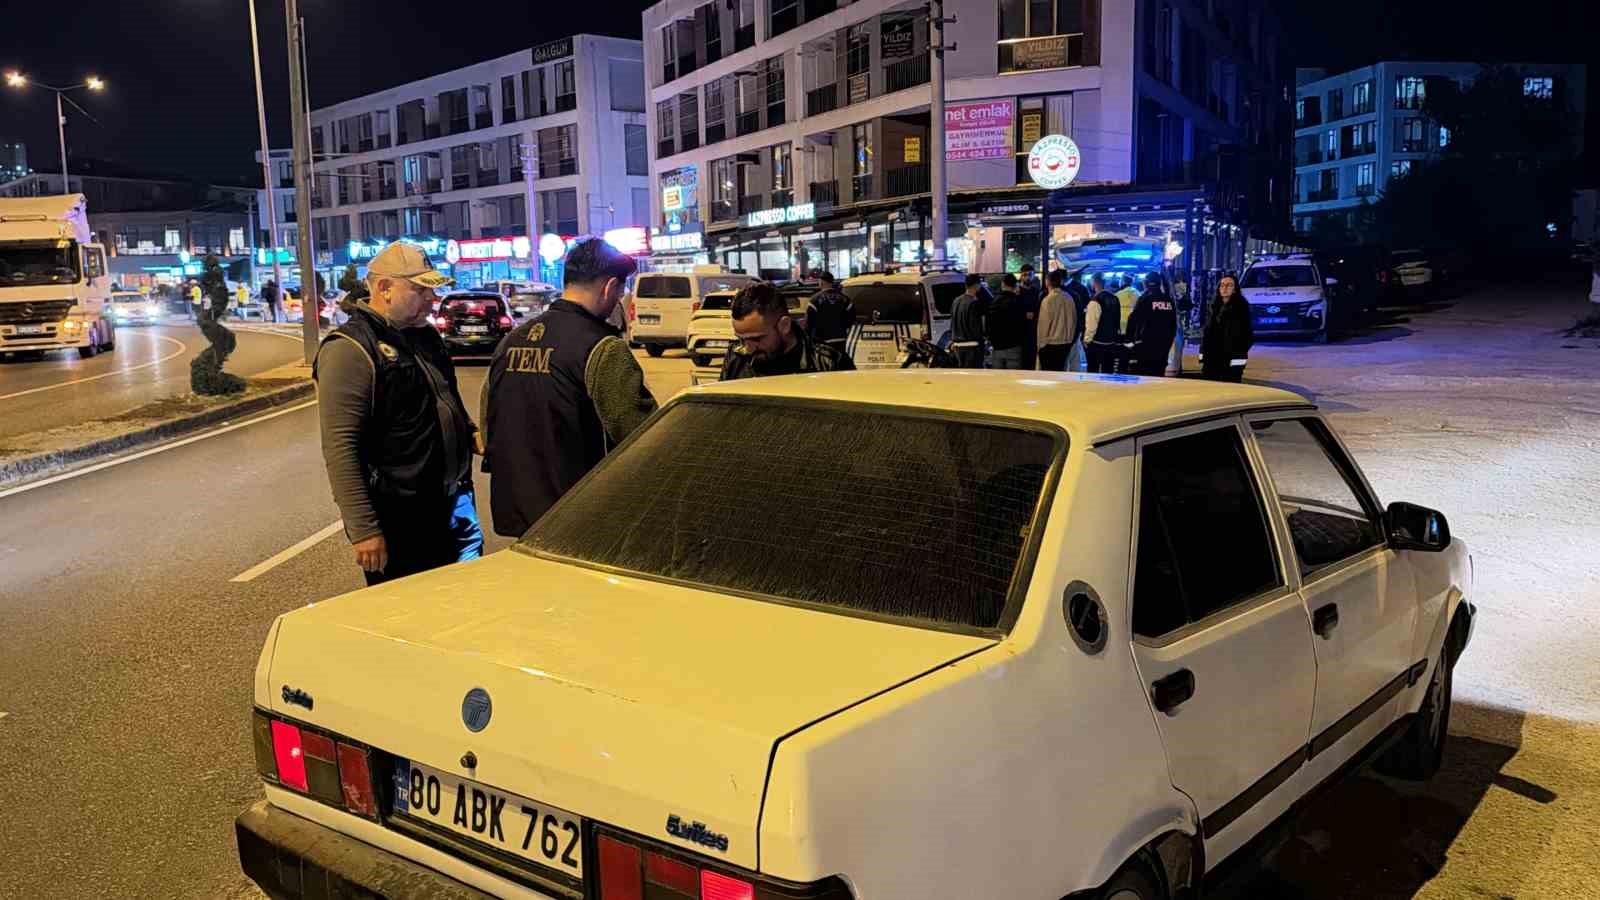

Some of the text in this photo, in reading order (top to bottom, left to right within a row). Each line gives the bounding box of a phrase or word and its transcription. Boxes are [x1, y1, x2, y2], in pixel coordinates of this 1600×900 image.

[945, 103, 1010, 121] net emlak
[786, 203, 814, 221] COFFEE
[506, 347, 554, 373] TEM
[410, 767, 580, 859] 80 ABK 762
